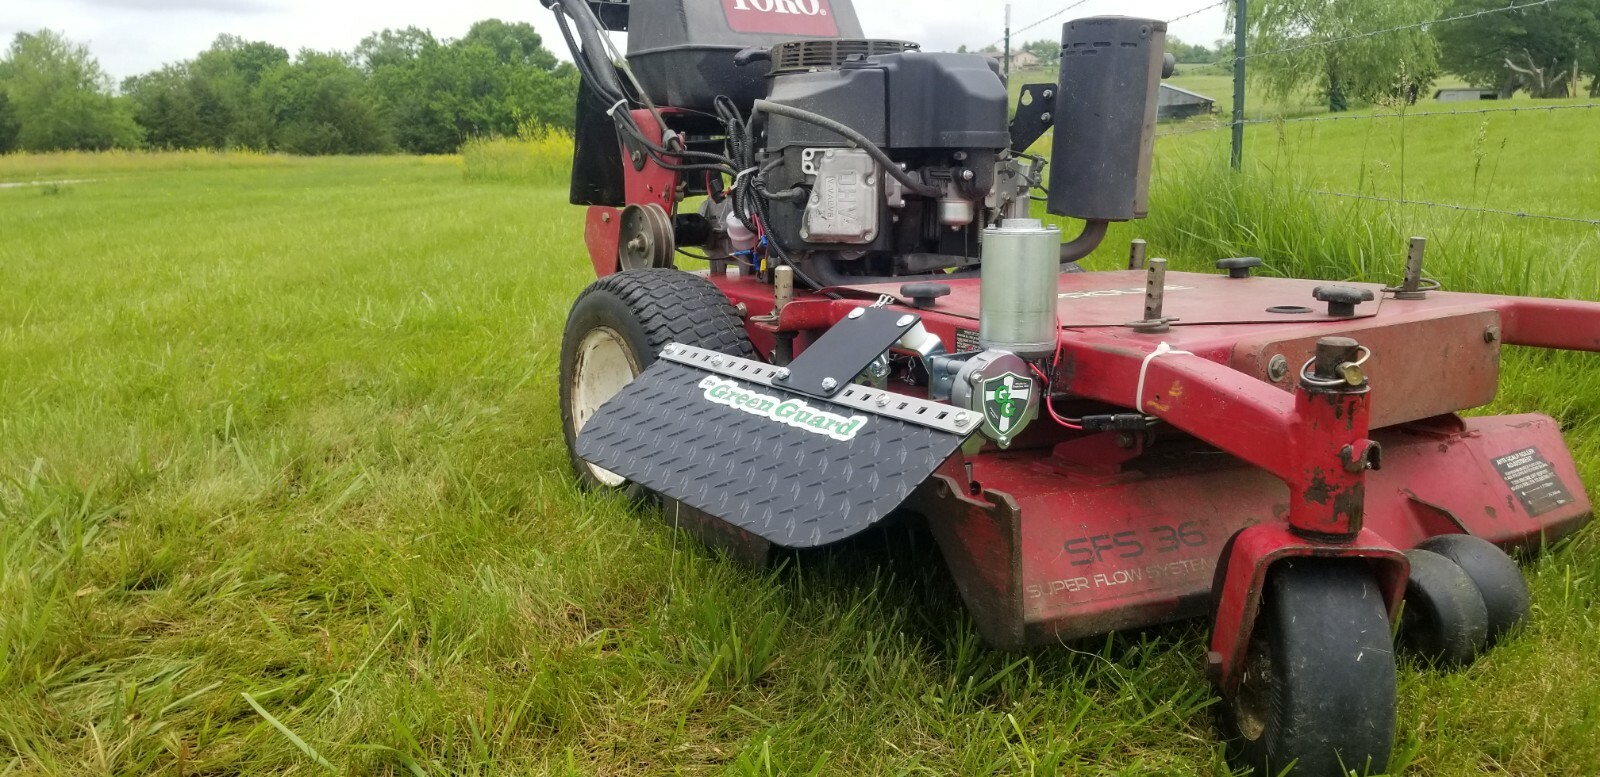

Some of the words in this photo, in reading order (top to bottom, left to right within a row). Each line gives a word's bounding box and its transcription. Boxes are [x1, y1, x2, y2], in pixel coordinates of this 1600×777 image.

[1063, 531, 1144, 566] SFS
[1026, 576, 1090, 599] SUPER
[1093, 568, 1142, 588] FLOW
